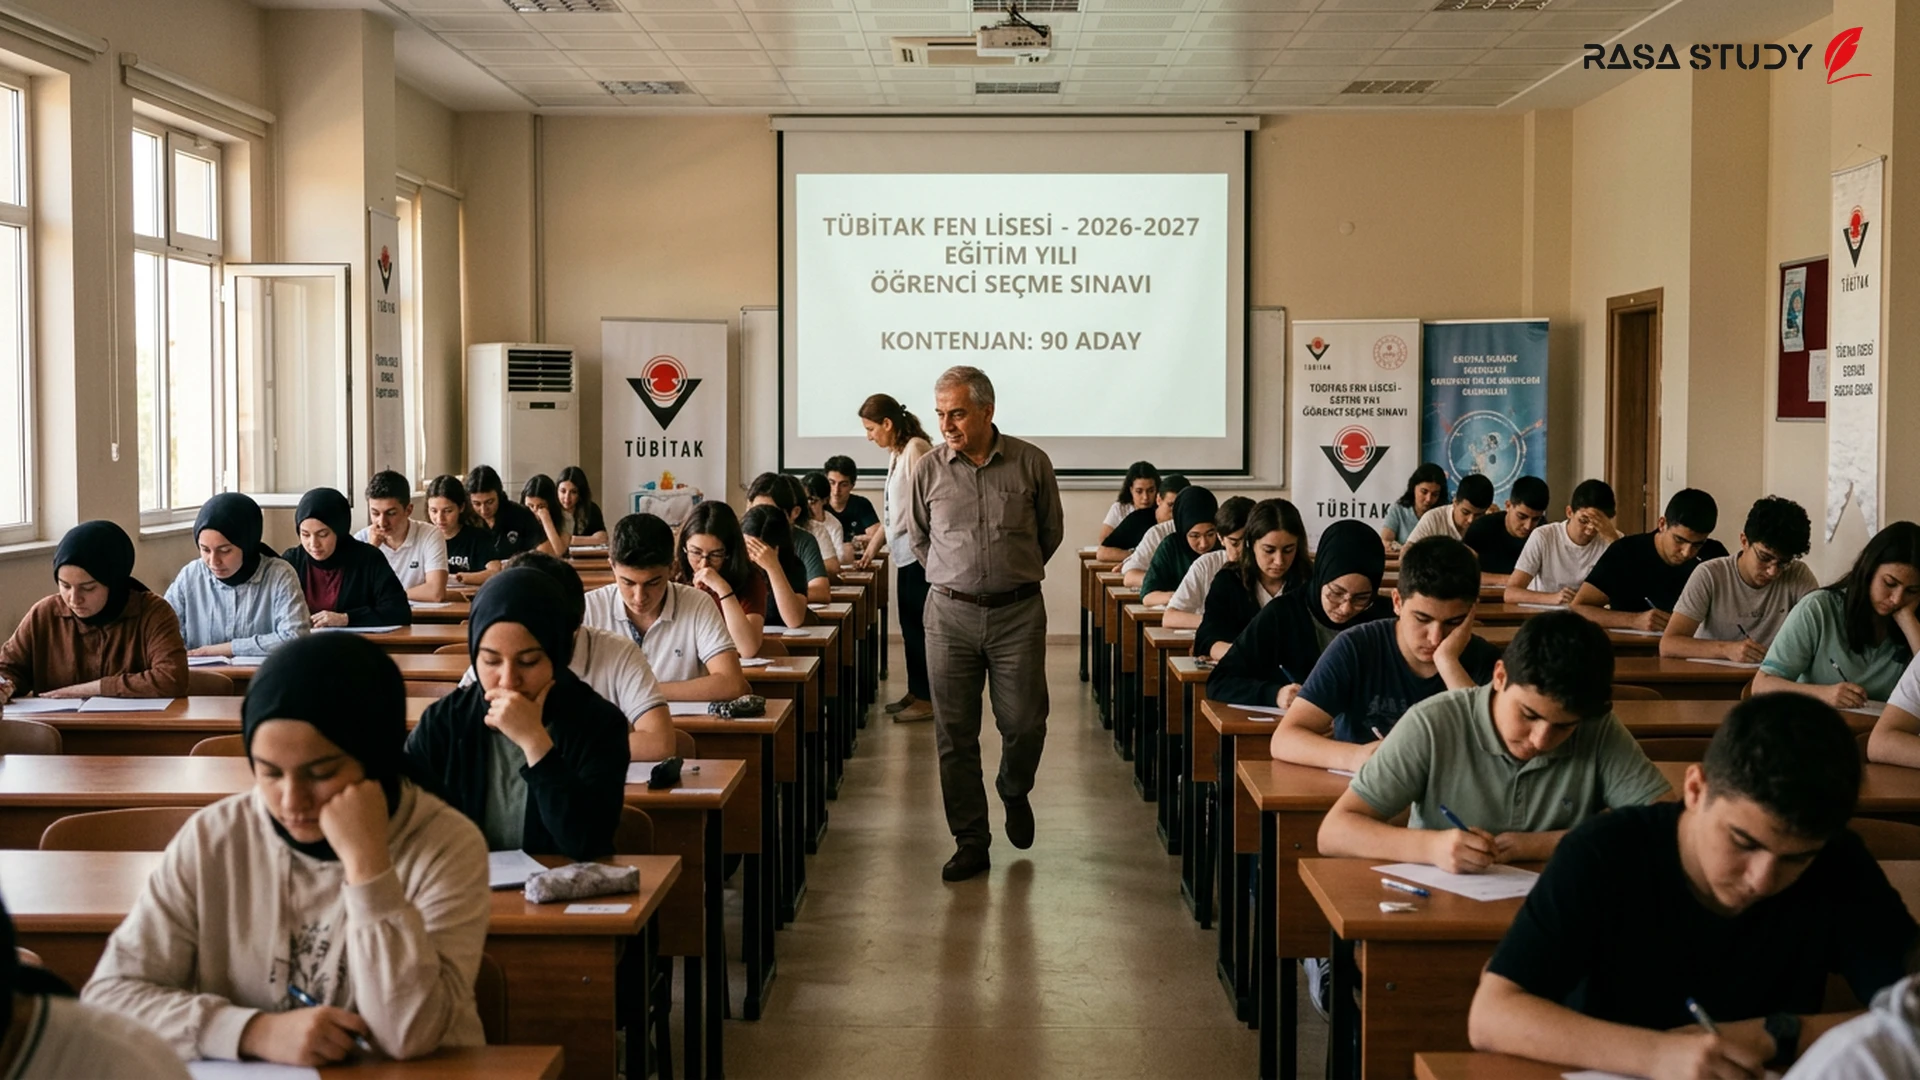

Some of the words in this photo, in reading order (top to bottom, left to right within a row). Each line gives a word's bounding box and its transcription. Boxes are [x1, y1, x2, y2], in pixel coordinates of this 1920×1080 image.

[823, 213, 925, 236] TÜBİTAK
[934, 217, 976, 236] FEN
[986, 213, 1052, 236] LİSESİ
[1078, 217, 1199, 236] 2026-2027
[945, 241, 1027, 265] EĞİTİM
[1036, 246, 1077, 265] YILI
[871, 270, 977, 294] ÖĞRENCİ
[985, 274, 1063, 299] SEÇME
[1070, 274, 1151, 294] SINAVI
[881, 331, 1033, 351] KONTENJAN:
[1040, 331, 1068, 351] 90
[1075, 331, 1142, 351] ADAY
[625, 435, 704, 459] TÜBİTAK
[1317, 498, 1391, 518] TÜBİTAK
